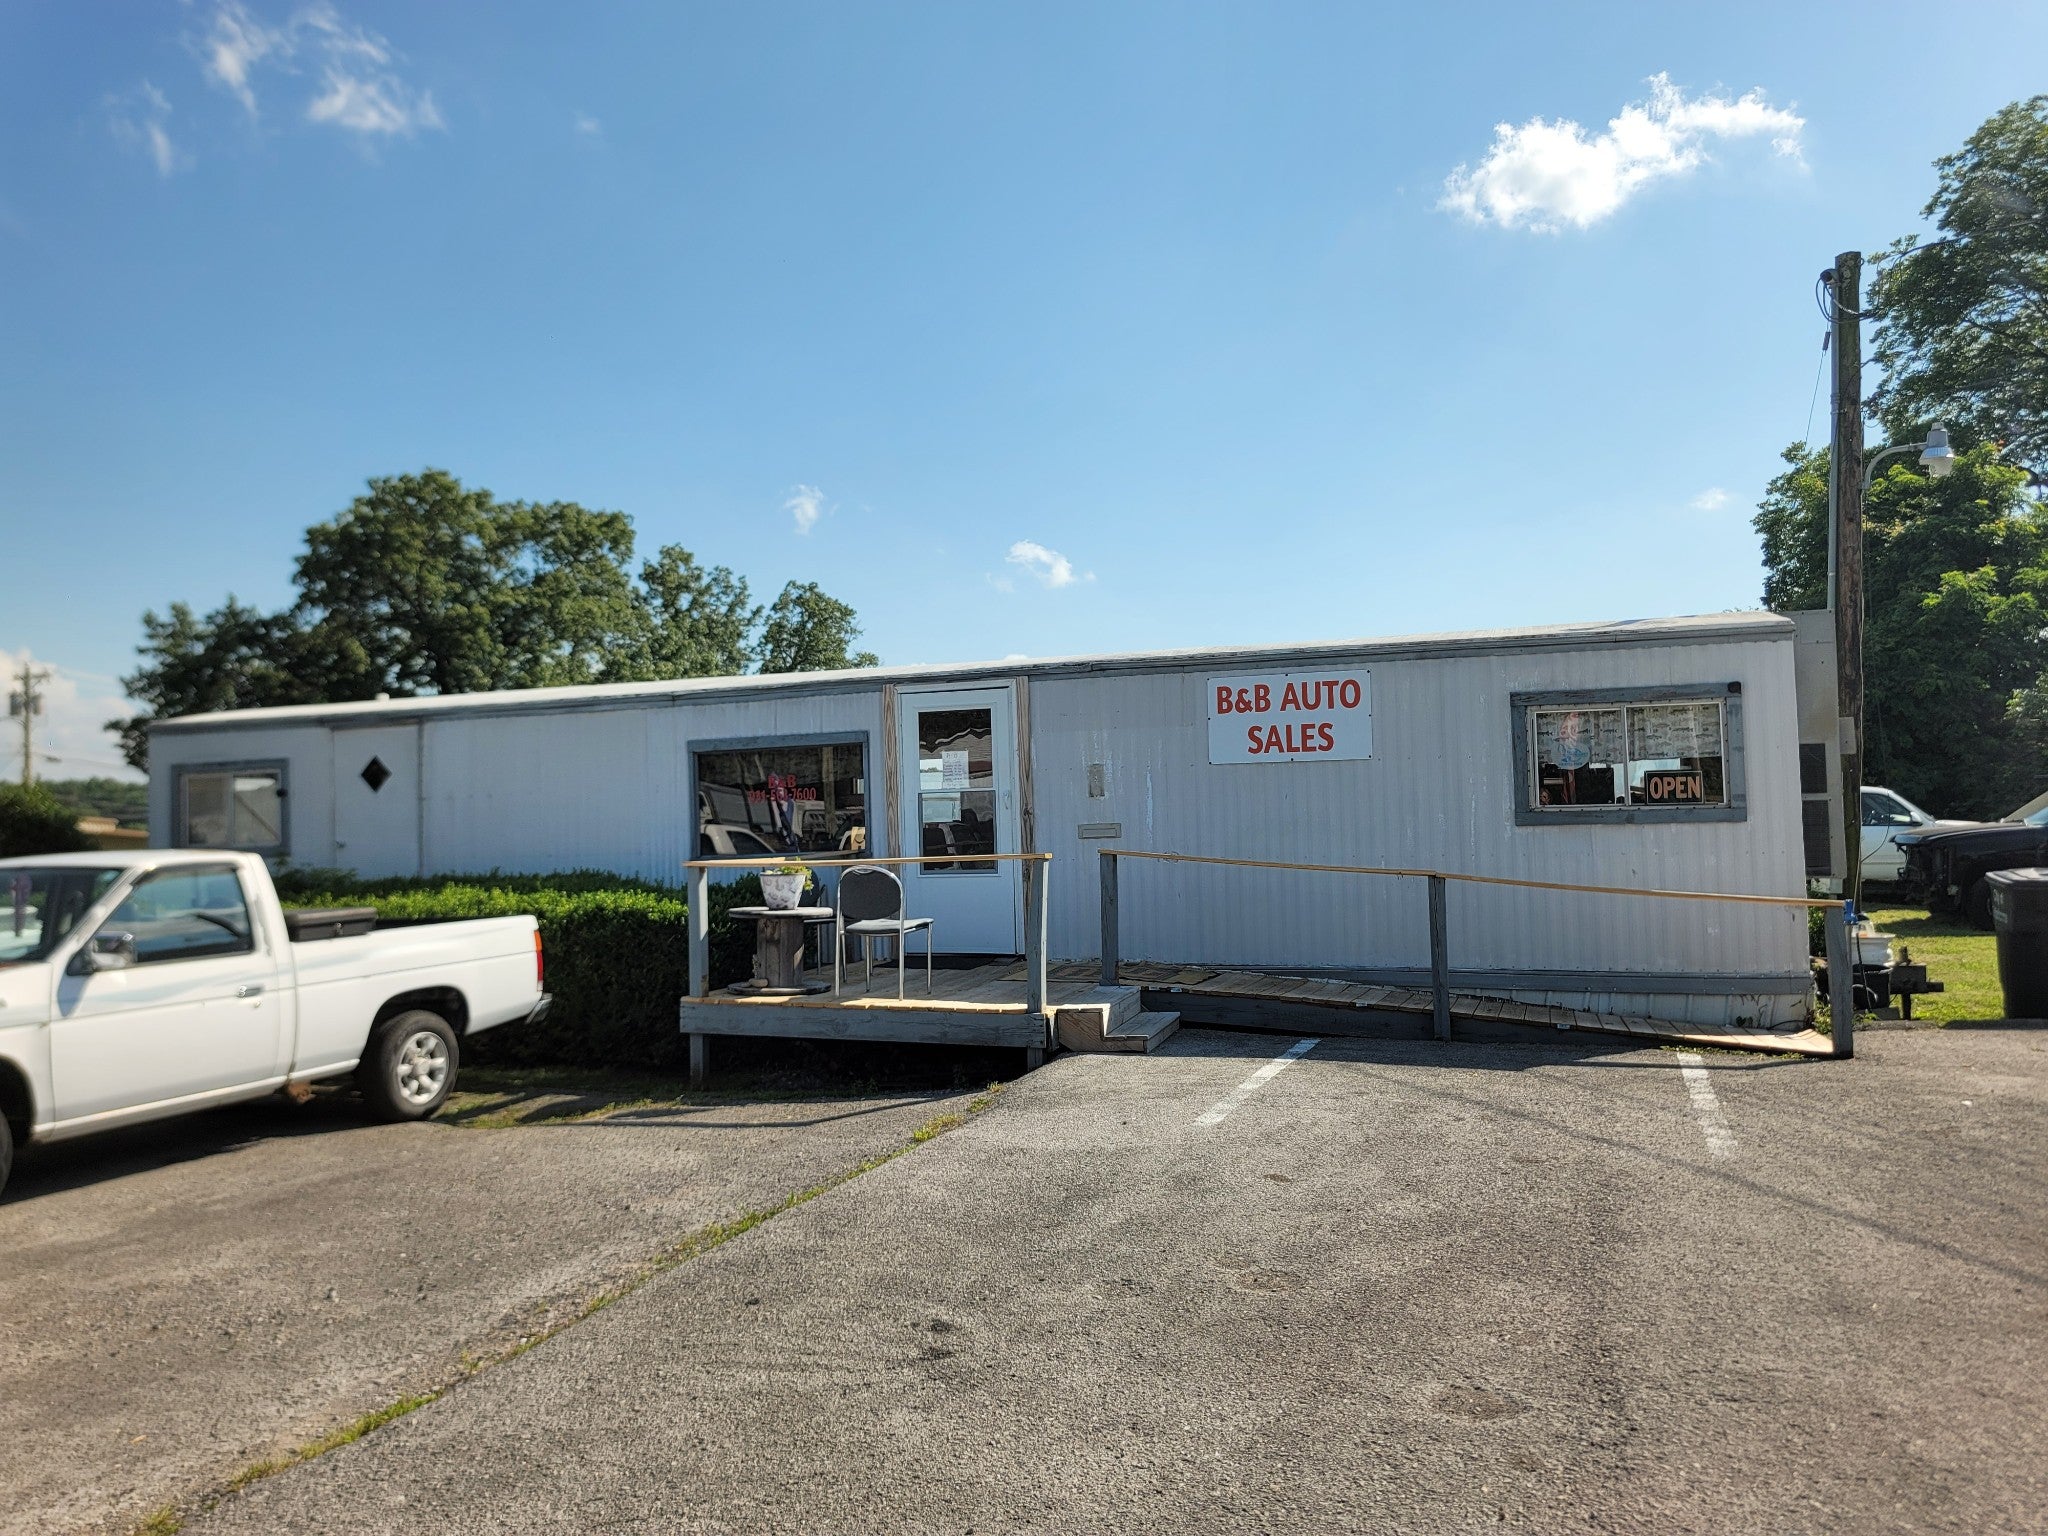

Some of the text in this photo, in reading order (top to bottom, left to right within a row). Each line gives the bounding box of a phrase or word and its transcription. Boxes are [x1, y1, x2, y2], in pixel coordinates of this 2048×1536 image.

[1216, 679, 1361, 715] B&B AUTO
[1247, 722, 1335, 755] SALES
[1649, 775, 1701, 800] OPEN
